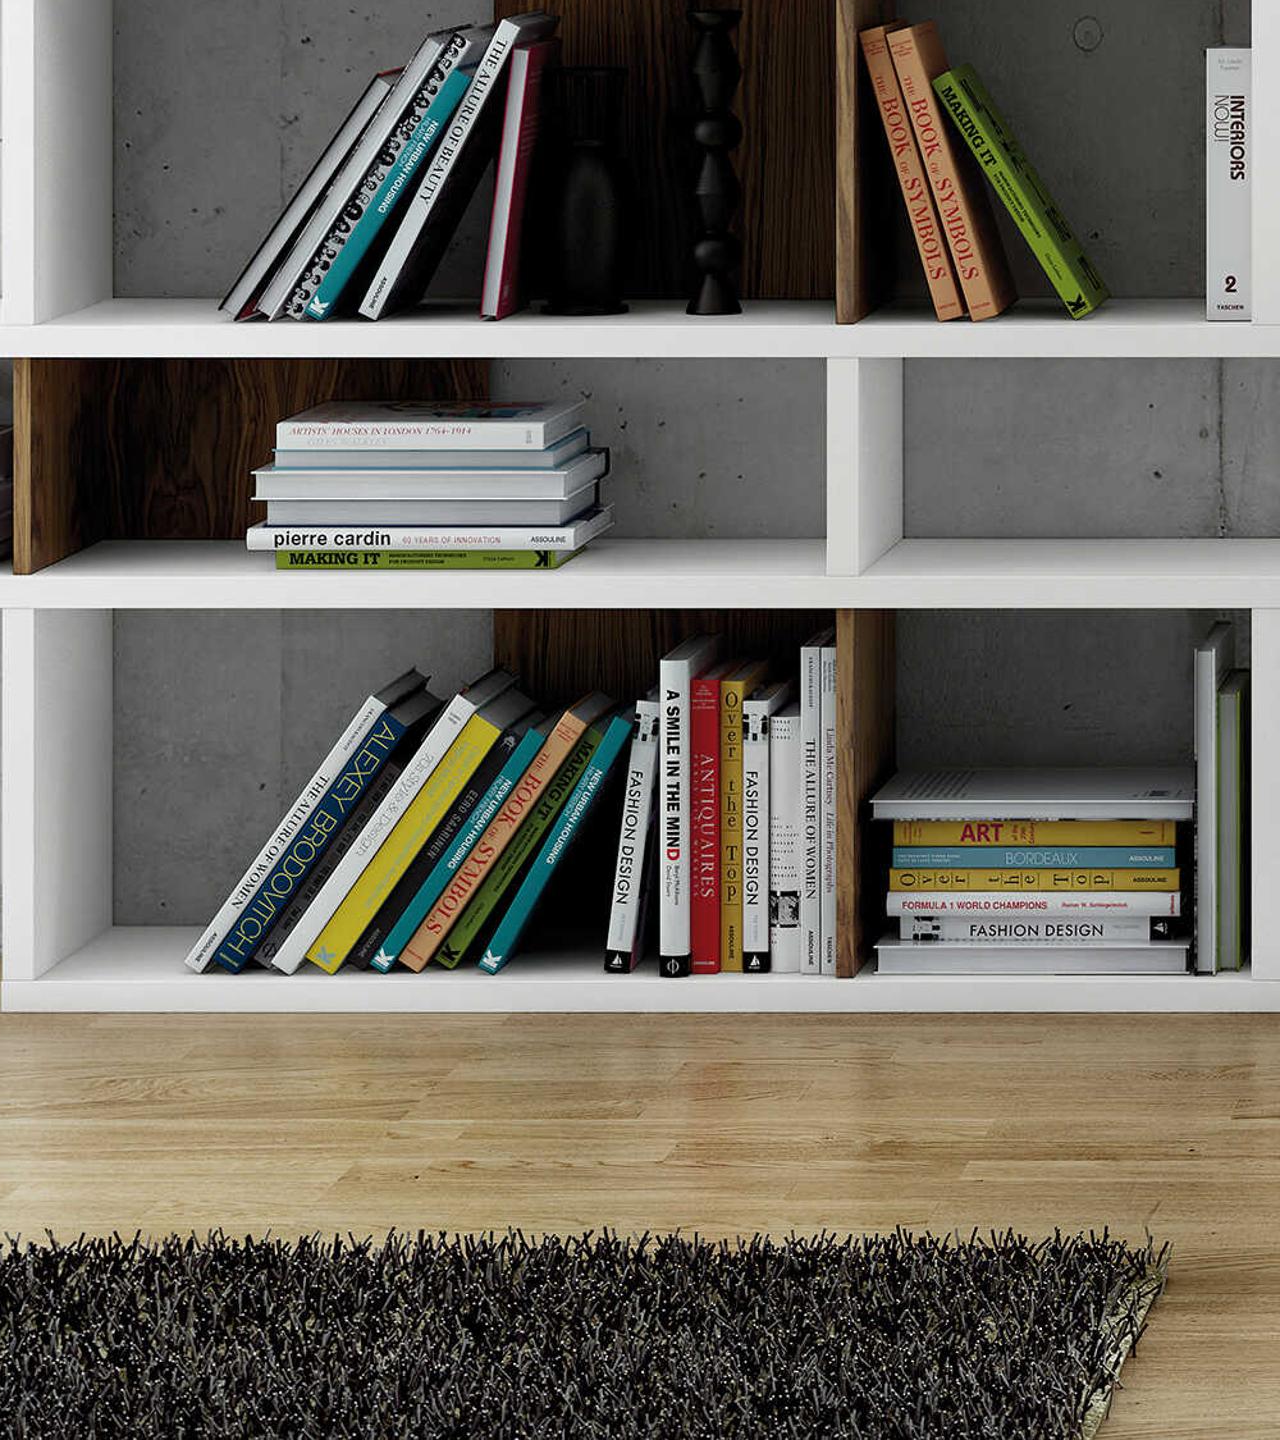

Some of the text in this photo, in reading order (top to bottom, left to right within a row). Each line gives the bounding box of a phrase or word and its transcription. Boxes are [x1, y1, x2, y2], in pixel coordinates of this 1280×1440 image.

[419, 40, 506, 201] THE ALLURE OF BEAUTY
[881, 96, 911, 157] BOOK
[941, 84, 985, 150] MAKING
[979, 147, 997, 169] IT
[1213, 94, 1230, 143] NOW!
[1229, 94, 1246, 181] INTERIORS
[376, 120, 438, 214] NEW URBAN HOUSING
[899, 159, 911, 176] OF
[910, 97, 942, 158] BOOK
[934, 177, 979, 280] SYMBOLS
[904, 177, 946, 280] SYMBOLS
[1216, 303, 1244, 311] TASCHEN
[1224, 274, 1237, 293] 2
[331, 426, 369, 436] HOUSES
[370, 426, 382, 436] IN
[383, 426, 422, 436] LONDON
[273, 530, 392, 549] pierre cardin
[288, 552, 381, 566] MAKING IT
[413, 535, 438, 545] YEARS
[439, 535, 452, 545] OF
[452, 535, 502, 545] INNOVATION
[530, 535, 567, 544] ASSOULINE
[331, 720, 392, 813] ALEXEY
[825, 727, 834, 753] Linda
[496, 772, 541, 828] BOOK
[536, 740, 593, 823] MAKING IT
[666, 689, 681, 862] A SMILE IN THE MIND
[725, 690, 738, 902] Over the Top
[230, 775, 330, 906] THE ALLURE OF WOMEN
[447, 778, 512, 871] NEW URBAN HOUSING
[544, 767, 604, 865] NEW URBAN HOUSING
[615, 770, 644, 906] FASHION DESIGN
[700, 754, 716, 899] ANTIQUAIRES
[745, 770, 759, 906] FASHION DESIGN
[805, 739, 817, 900] THE ALLURE OF WOMEN
[825, 811, 834, 829] Life
[825, 830, 834, 839] in
[959, 823, 1004, 843] ART
[228, 804, 337, 955] BRODOVITCH
[425, 839, 497, 936] SYMBOLS
[824, 840, 834, 893] Photographs
[899, 872, 1110, 887] Over the Top
[1004, 851, 1079, 866] BORDEAUX
[901, 900, 1048, 910] FORMULA 1 WORLD CHAMPIONS
[969, 923, 1104, 937] FASHION DESIGN
